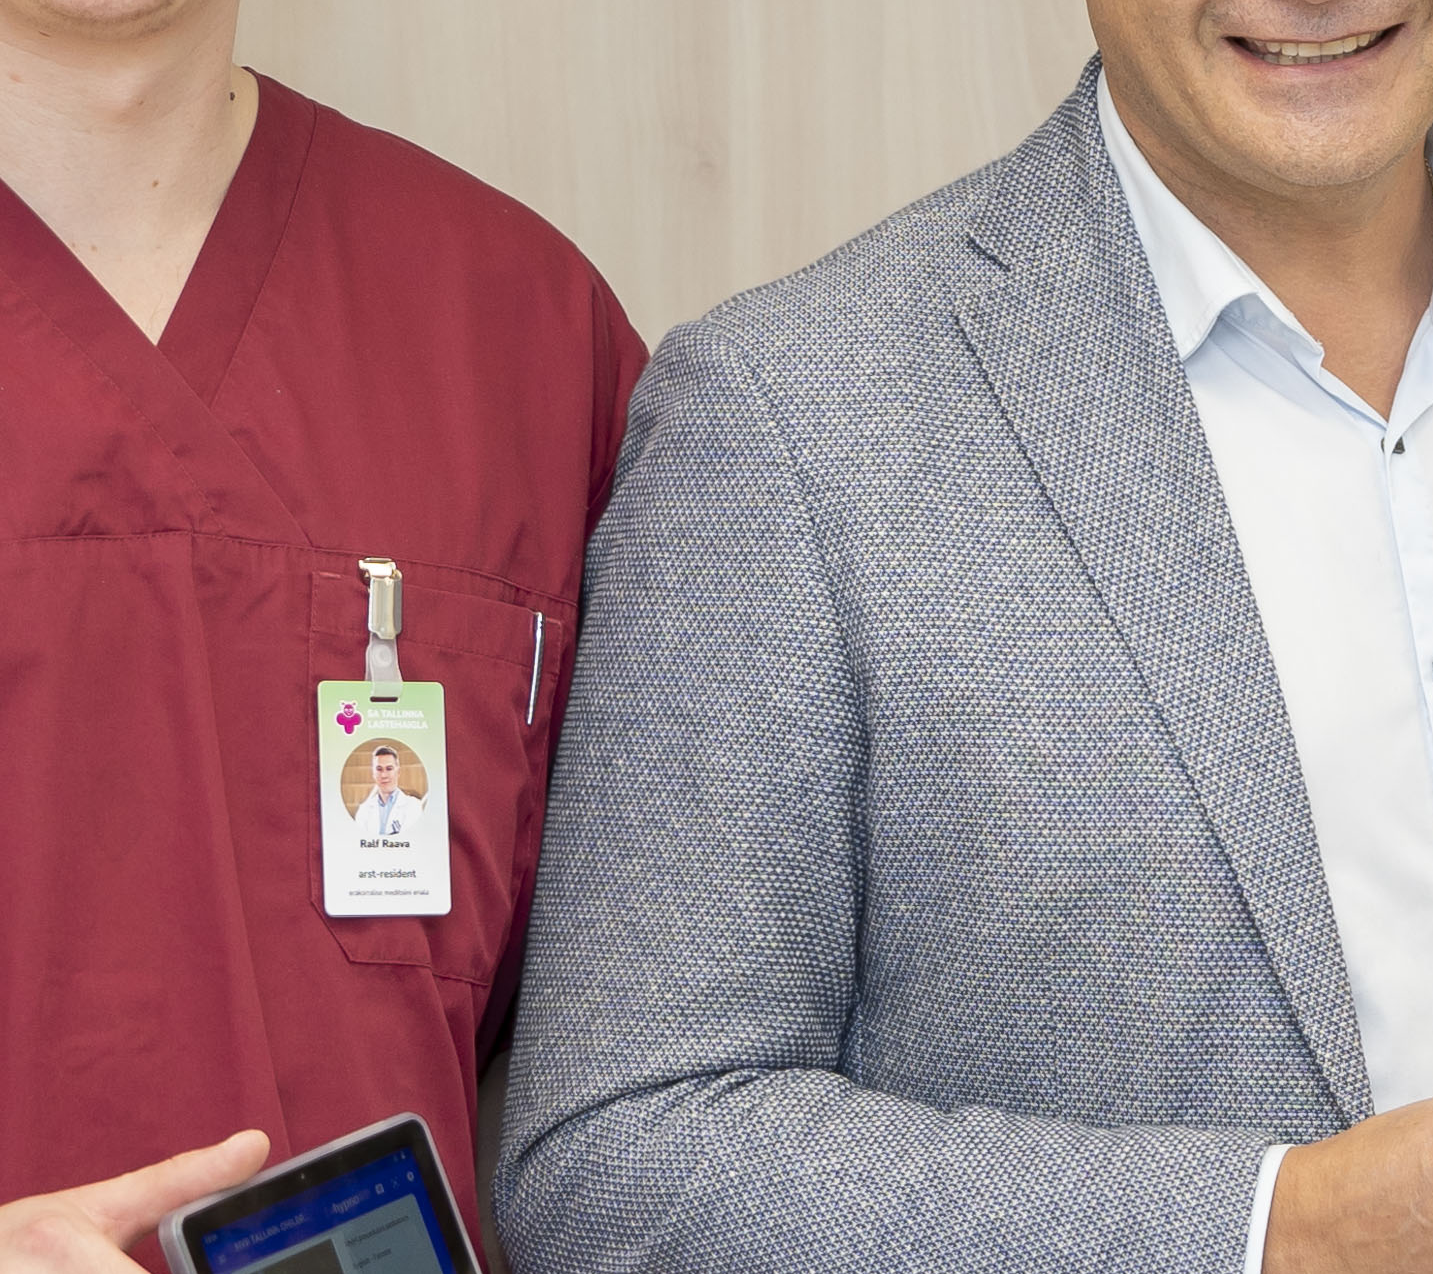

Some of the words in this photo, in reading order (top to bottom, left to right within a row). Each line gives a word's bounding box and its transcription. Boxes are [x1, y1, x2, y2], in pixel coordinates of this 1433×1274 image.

[360, 839, 380, 848] Ralf
[382, 839, 411, 848] Raava
[358, 869, 417, 879] arst-resident
